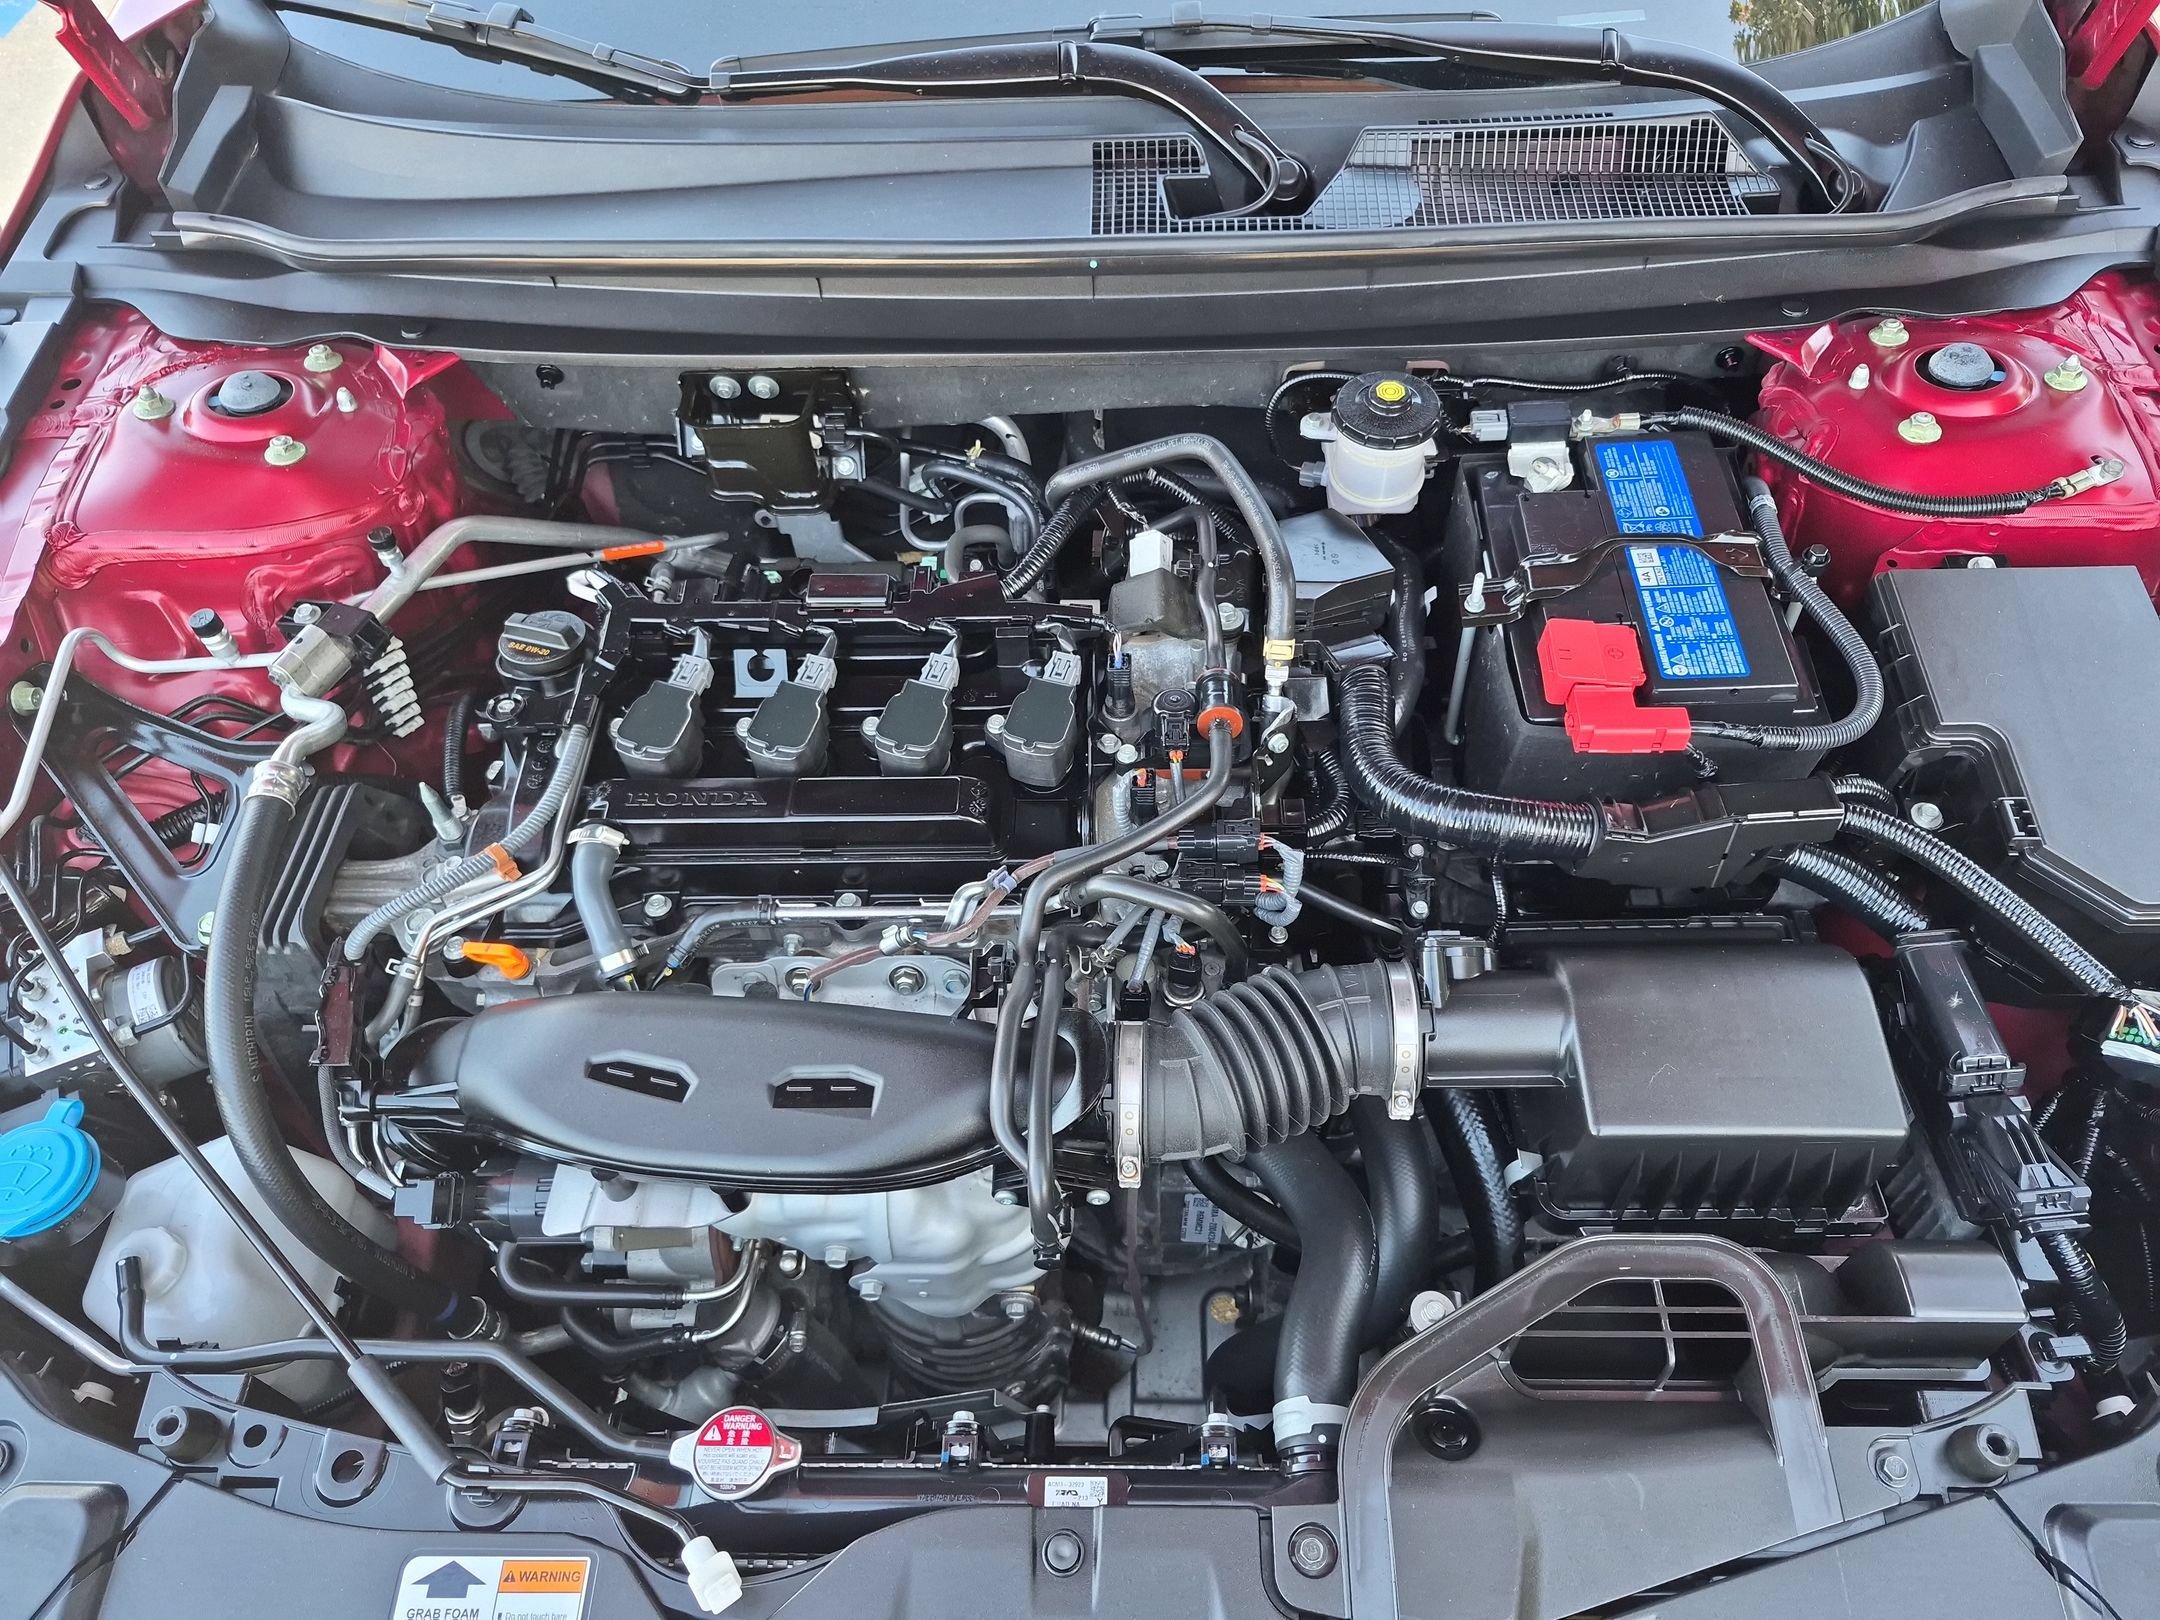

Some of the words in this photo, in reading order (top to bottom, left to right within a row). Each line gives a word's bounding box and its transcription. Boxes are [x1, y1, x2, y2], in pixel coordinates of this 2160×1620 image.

[507, 641, 526, 651] SAE
[625, 791, 768, 807] HONDA
[724, 1414, 756, 1422] DANGER
[723, 1422, 762, 1430] WARNUNG
[519, 1570, 581, 1583] WARNING
[406, 1608, 441, 1619] GRAB
[444, 1608, 480, 1618] FOAM
